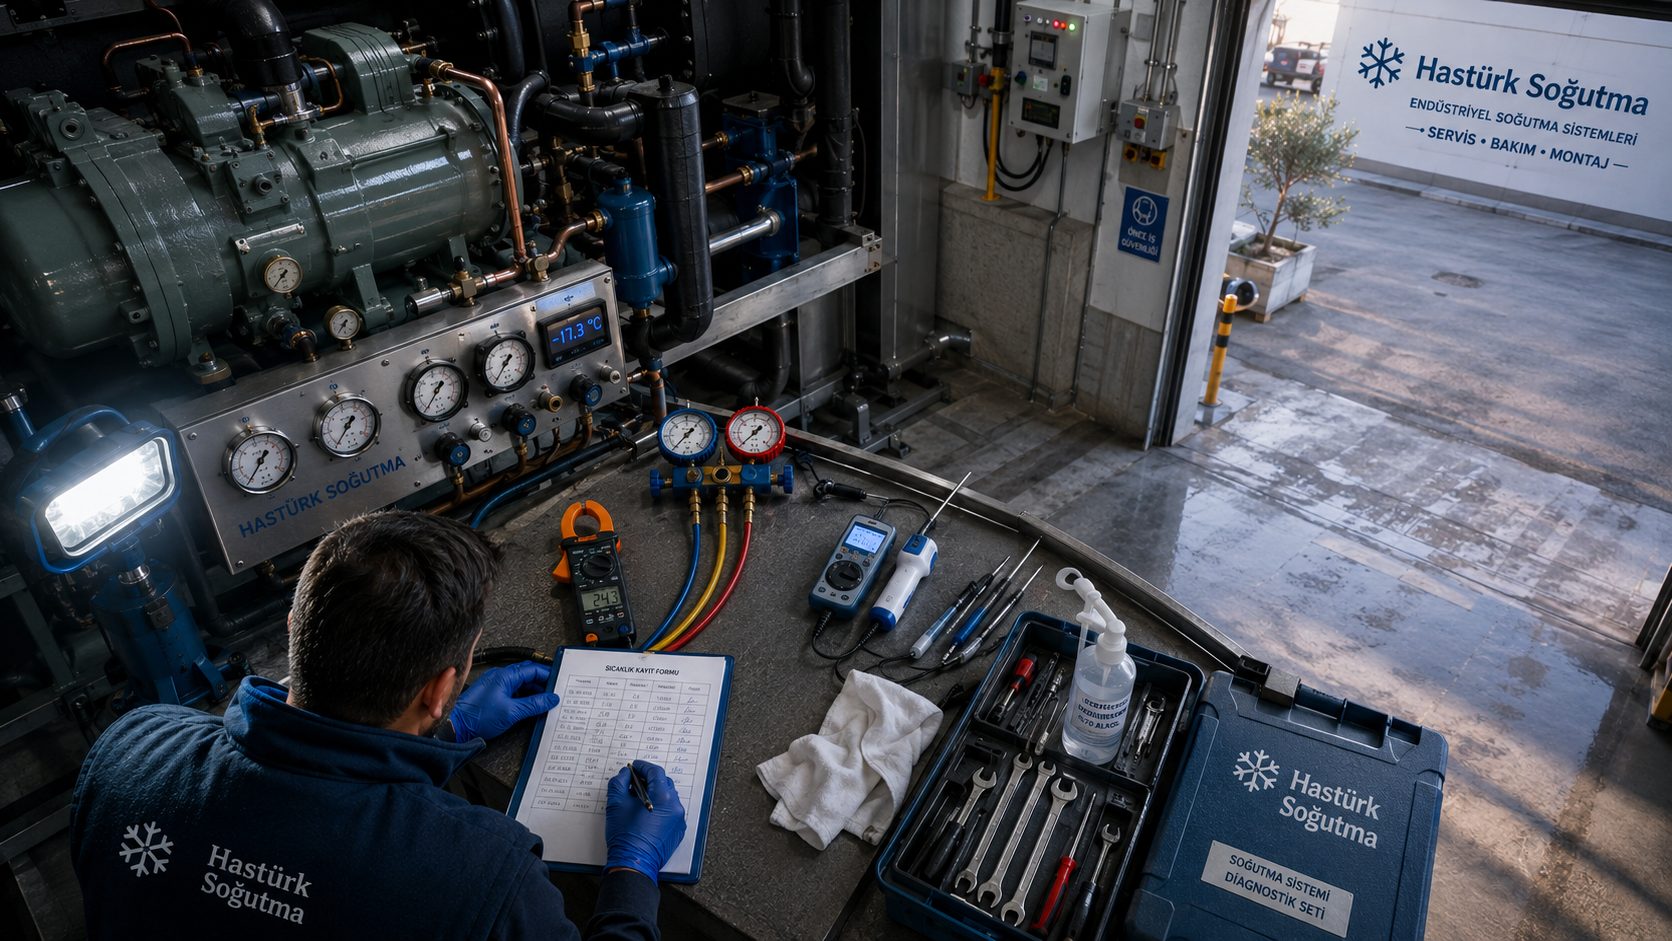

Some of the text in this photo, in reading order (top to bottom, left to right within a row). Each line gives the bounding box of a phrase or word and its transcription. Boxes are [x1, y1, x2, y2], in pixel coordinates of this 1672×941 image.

[1416, 55, 1650, 116] Hastürk Soğutma
[1409, 97, 1639, 146] ENDÜSTRİYEL SOĞUTMA SİSTEMLERİ
[1427, 126, 1610, 170] SERVİS BAKIM MONTAJ
[552, 315, 602, 344] -17.3 °C
[238, 455, 407, 538] HASTÜRK SOĞUTMA
[605, 664, 635, 673] SICAKLIK
[656, 668, 680, 676] FORMU
[1289, 769, 1382, 821] Hastürk
[1279, 795, 1379, 849] Soğutma
[207, 844, 312, 898] Hastürk
[1225, 871, 1326, 920] DİAGNOSTİK SETİ
[1229, 854, 1331, 902] SOĞUTMA SİSTEMİ
[200, 872, 305, 925] Soğutma
